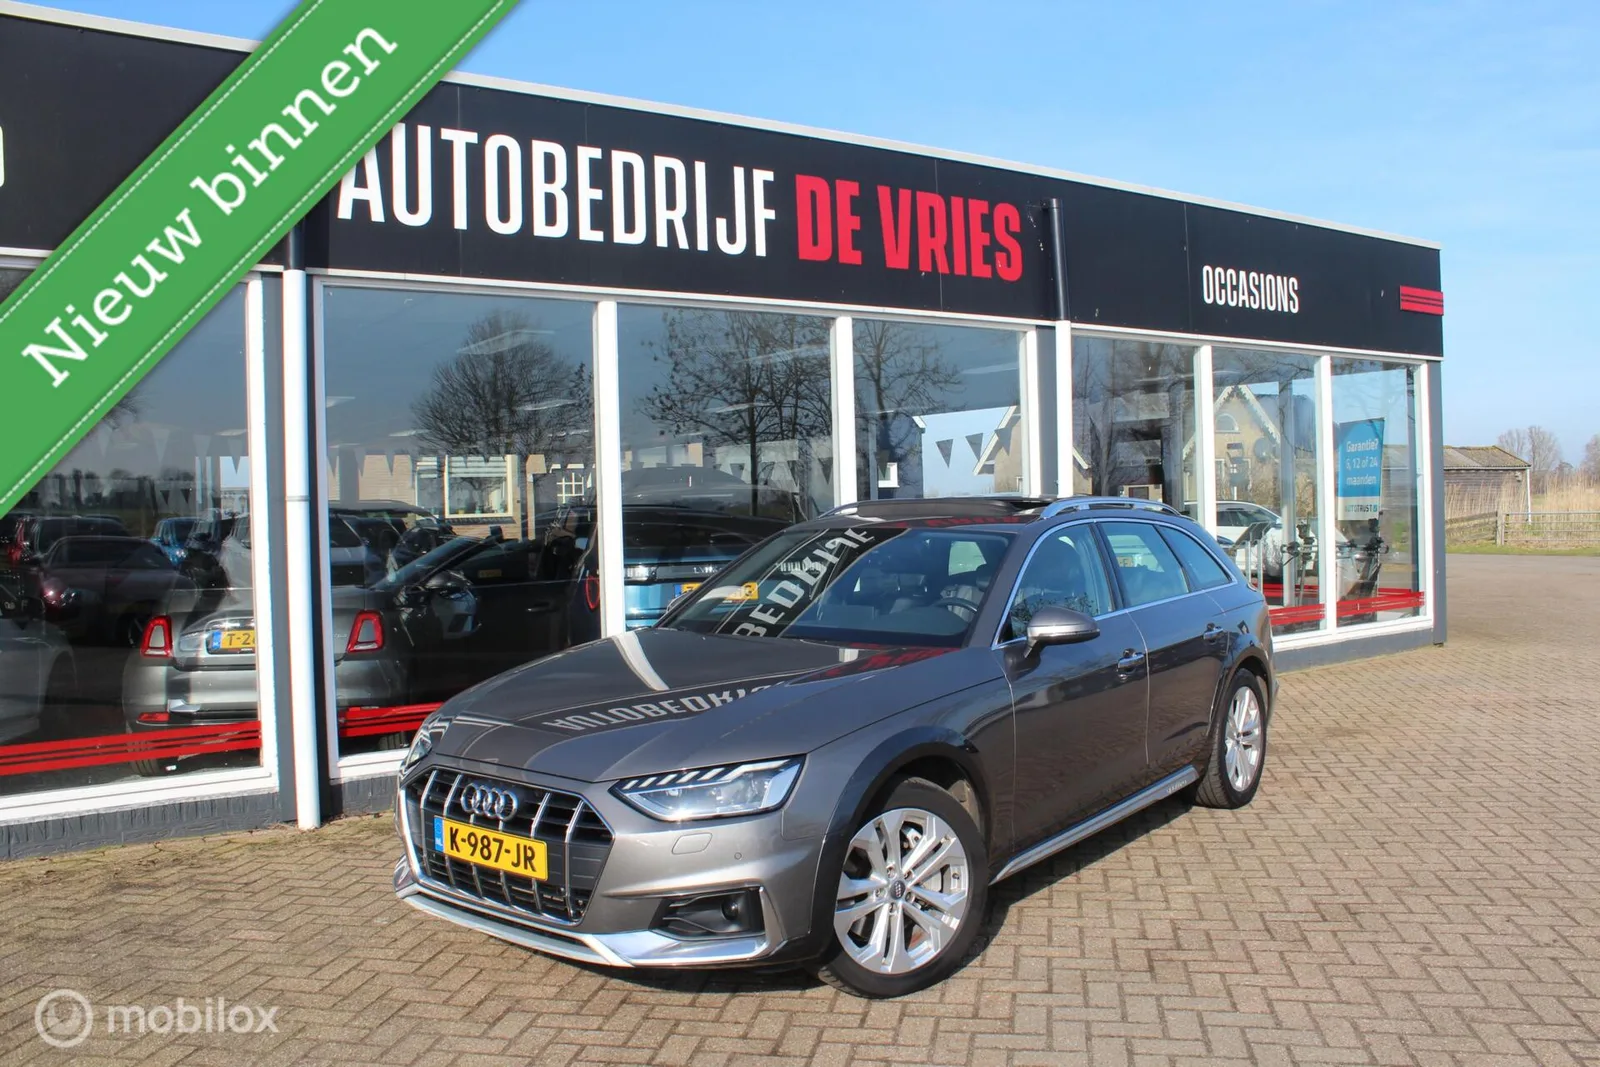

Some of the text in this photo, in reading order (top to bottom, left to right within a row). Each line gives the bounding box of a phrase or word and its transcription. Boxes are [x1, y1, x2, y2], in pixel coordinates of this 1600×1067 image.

[337, 122, 1023, 282] AUTOBEDRIJF DE VRIES
[1202, 265, 1299, 314] OCCASIONS
[1346, 438, 1379, 453] Garantie?
[1353, 457, 1361, 469] 12
[1362, 456, 1369, 468] of
[1346, 474, 1377, 486] maanden
[450, 826, 537, 873] K-987-JR
